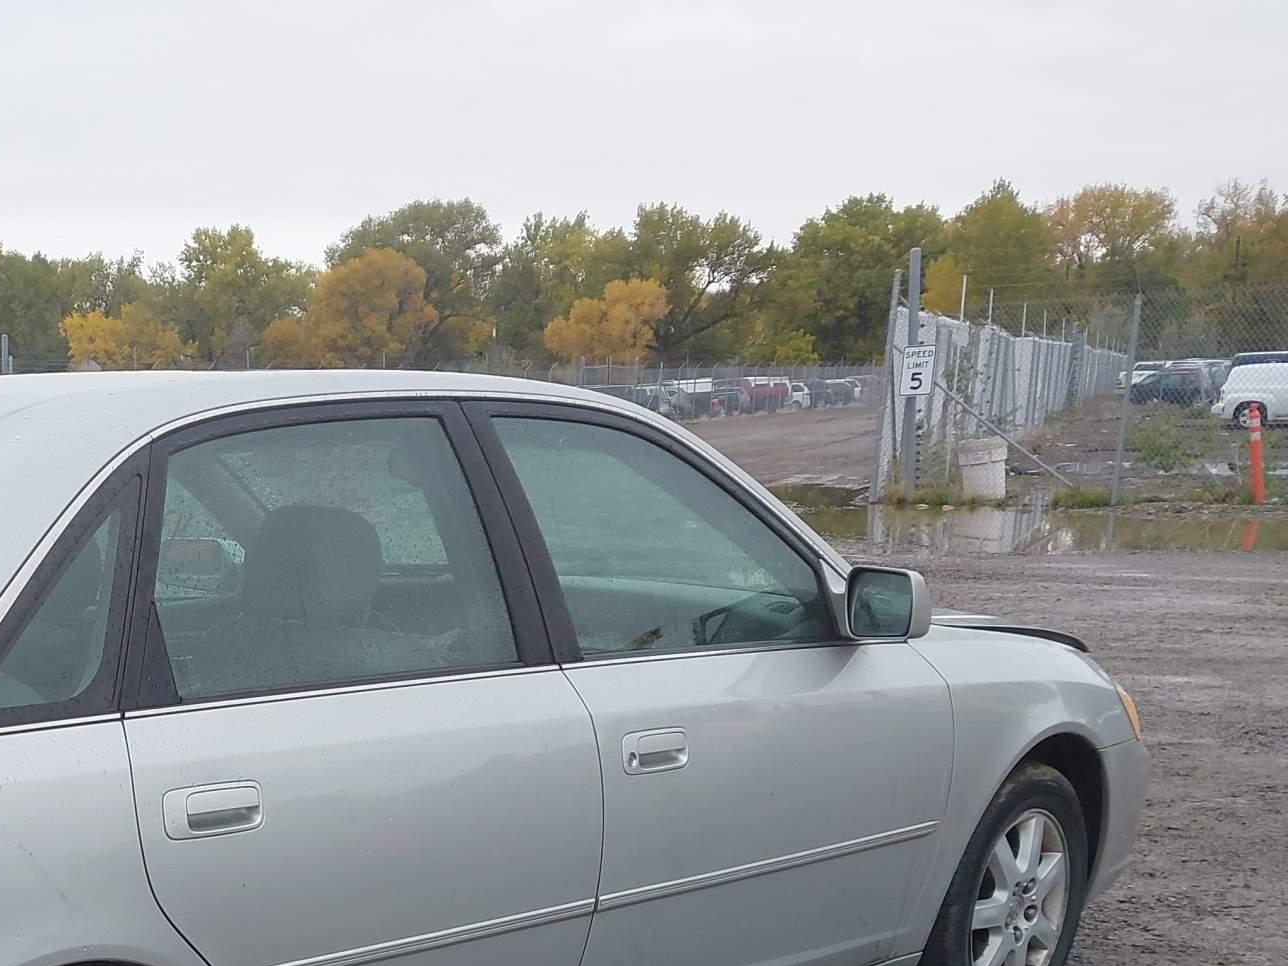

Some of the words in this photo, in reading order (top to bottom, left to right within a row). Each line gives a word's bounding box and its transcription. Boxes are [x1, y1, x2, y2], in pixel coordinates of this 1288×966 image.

[905, 350, 934, 359] SPEED
[907, 360, 929, 369] LIMIT
[910, 372, 923, 390] 5
